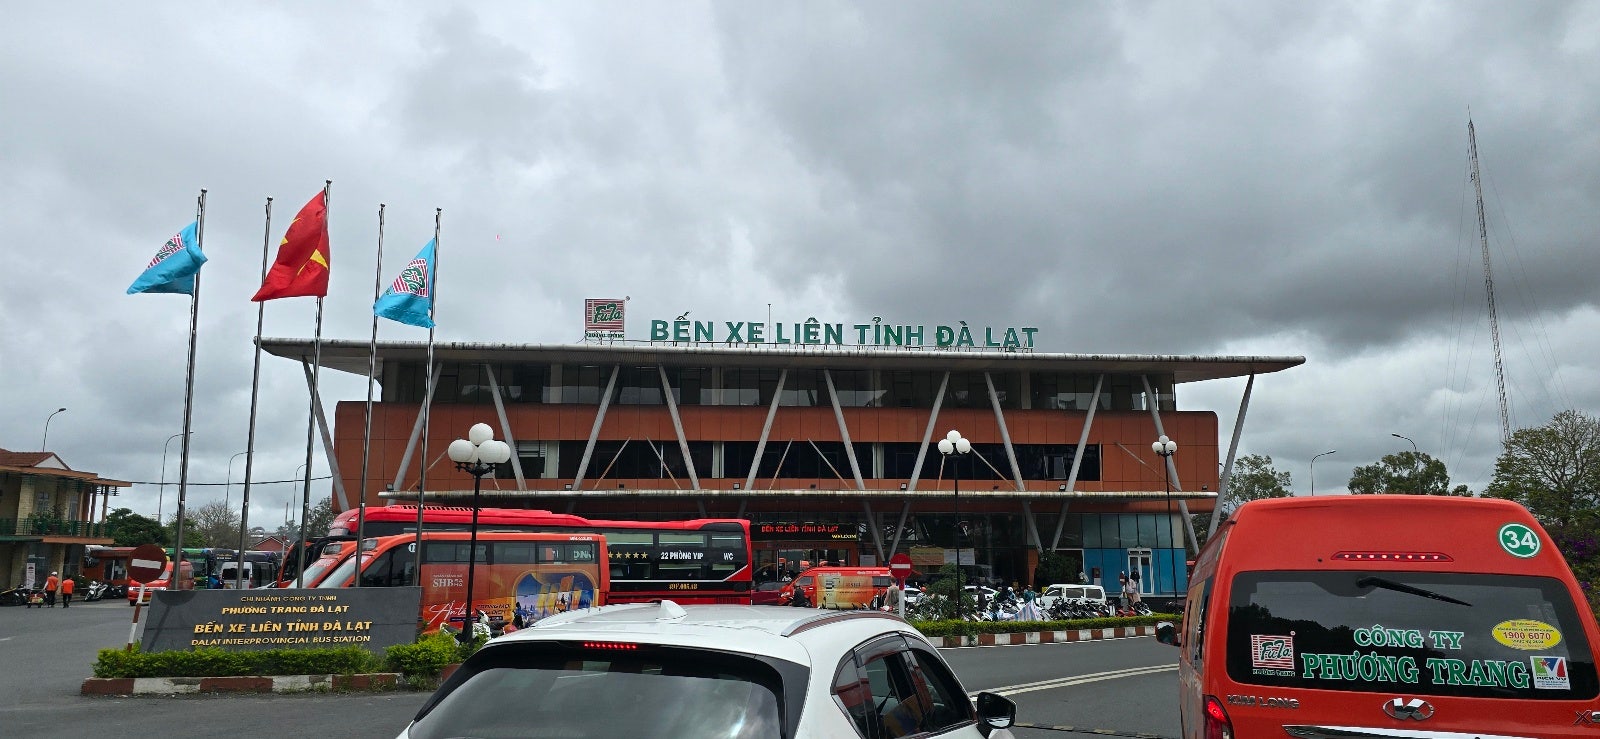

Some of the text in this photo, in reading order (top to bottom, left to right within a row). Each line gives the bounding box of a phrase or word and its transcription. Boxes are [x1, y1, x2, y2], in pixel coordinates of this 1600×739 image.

[651, 311, 1039, 352] BẾN XE LIÊN TỈNH ĐÀ LẠT
[1504, 530, 1537, 550] 34
[660, 550, 704, 560] 22 PHÒNG VIP
[723, 552, 734, 561] WC
[432, 578, 454, 588] SHB
[221, 604, 350, 615] PHƯƠNG TRANG ĐÀ LẠT
[194, 619, 373, 634] BẾN XE LIÊN TỈNH ĐÀ LẠT
[191, 638, 221, 646] DALAT
[222, 637, 309, 645] INTERPROVINCIAL
[332, 635, 371, 643] STATION
[1353, 624, 1465, 649] CÔNG TY
[1503, 631, 1552, 641] 1900 6070
[1301, 650, 1530, 688] PHƯƠNG TRANG
[1227, 694, 1300, 709] KIM LONG
